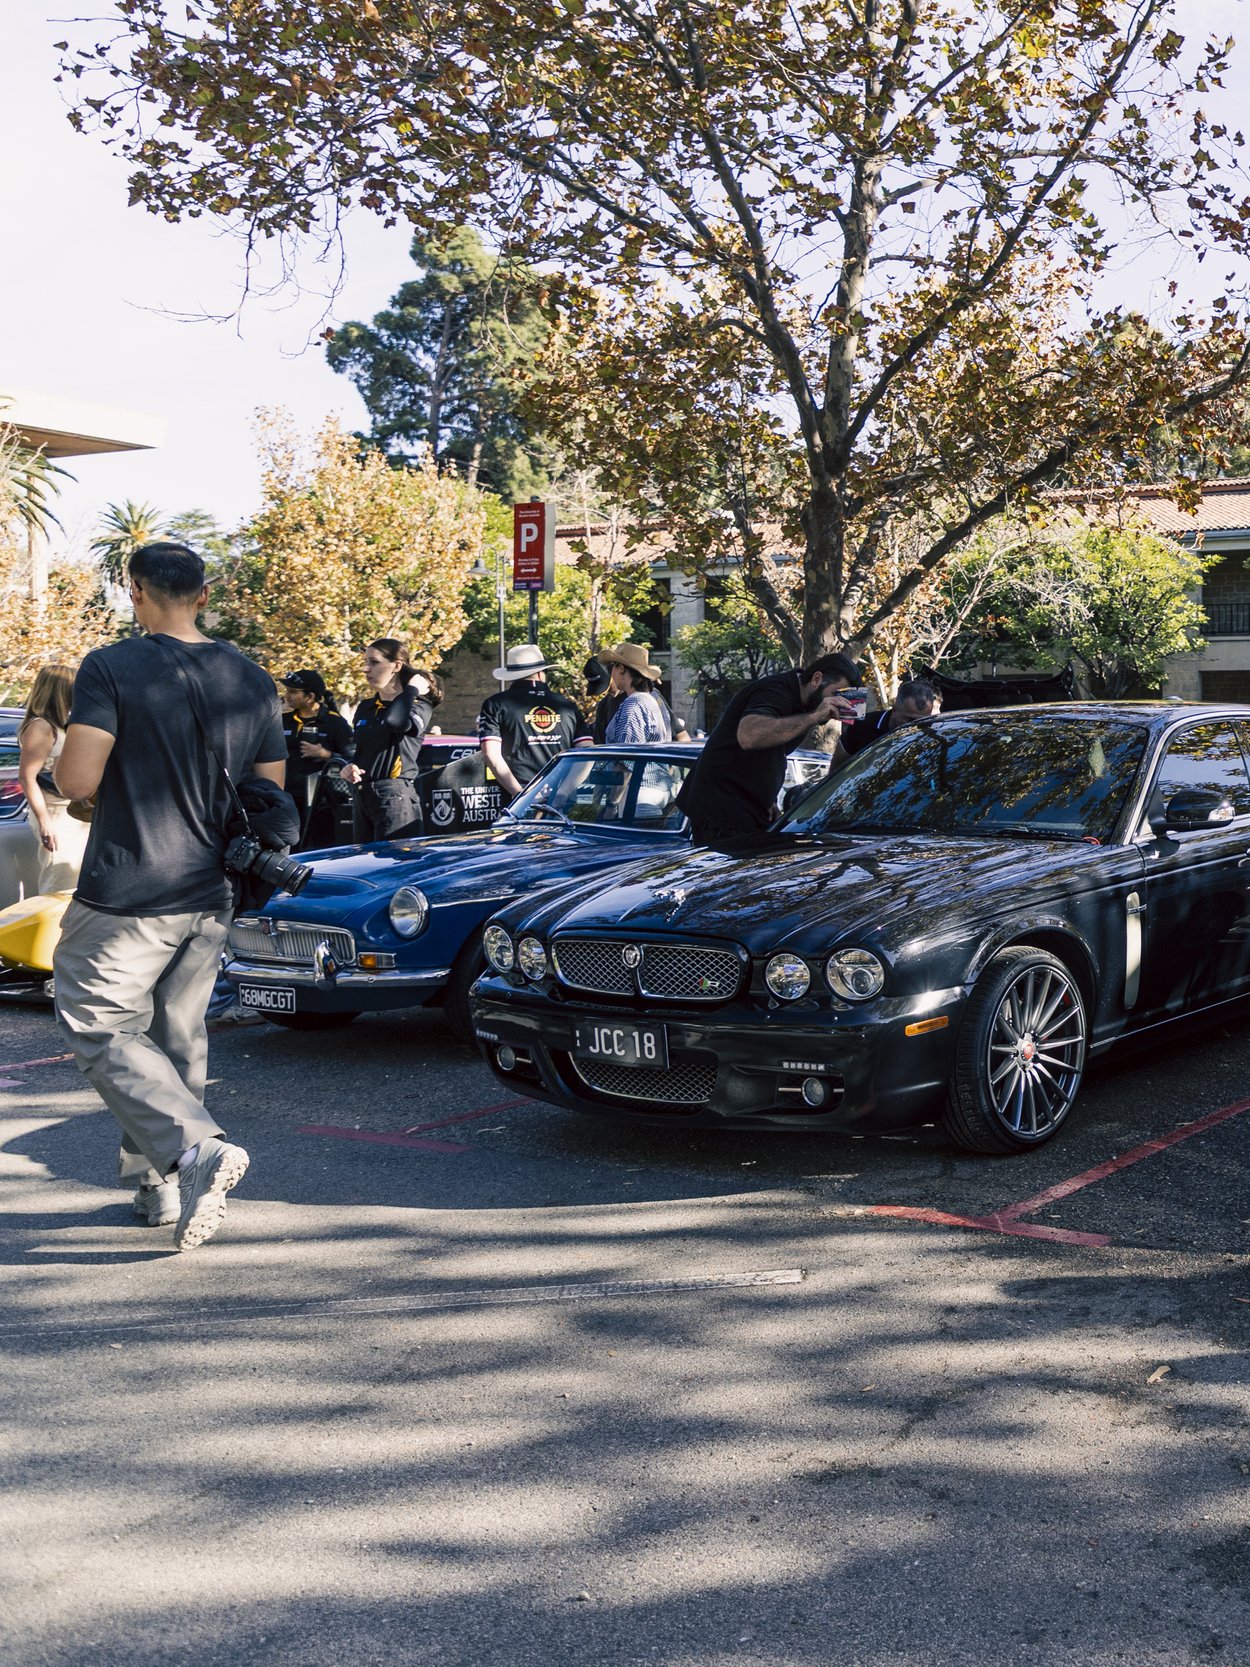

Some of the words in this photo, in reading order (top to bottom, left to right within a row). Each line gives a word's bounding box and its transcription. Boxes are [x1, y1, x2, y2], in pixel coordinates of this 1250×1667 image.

[521, 523, 538, 552] P
[524, 714, 561, 723] PENRITE
[460, 787, 474, 795] THE
[474, 786, 501, 794] UNIVER
[244, 988, 293, 1009] 68MGCGT
[589, 1027, 625, 1056] JCC
[632, 1031, 656, 1059] 18
